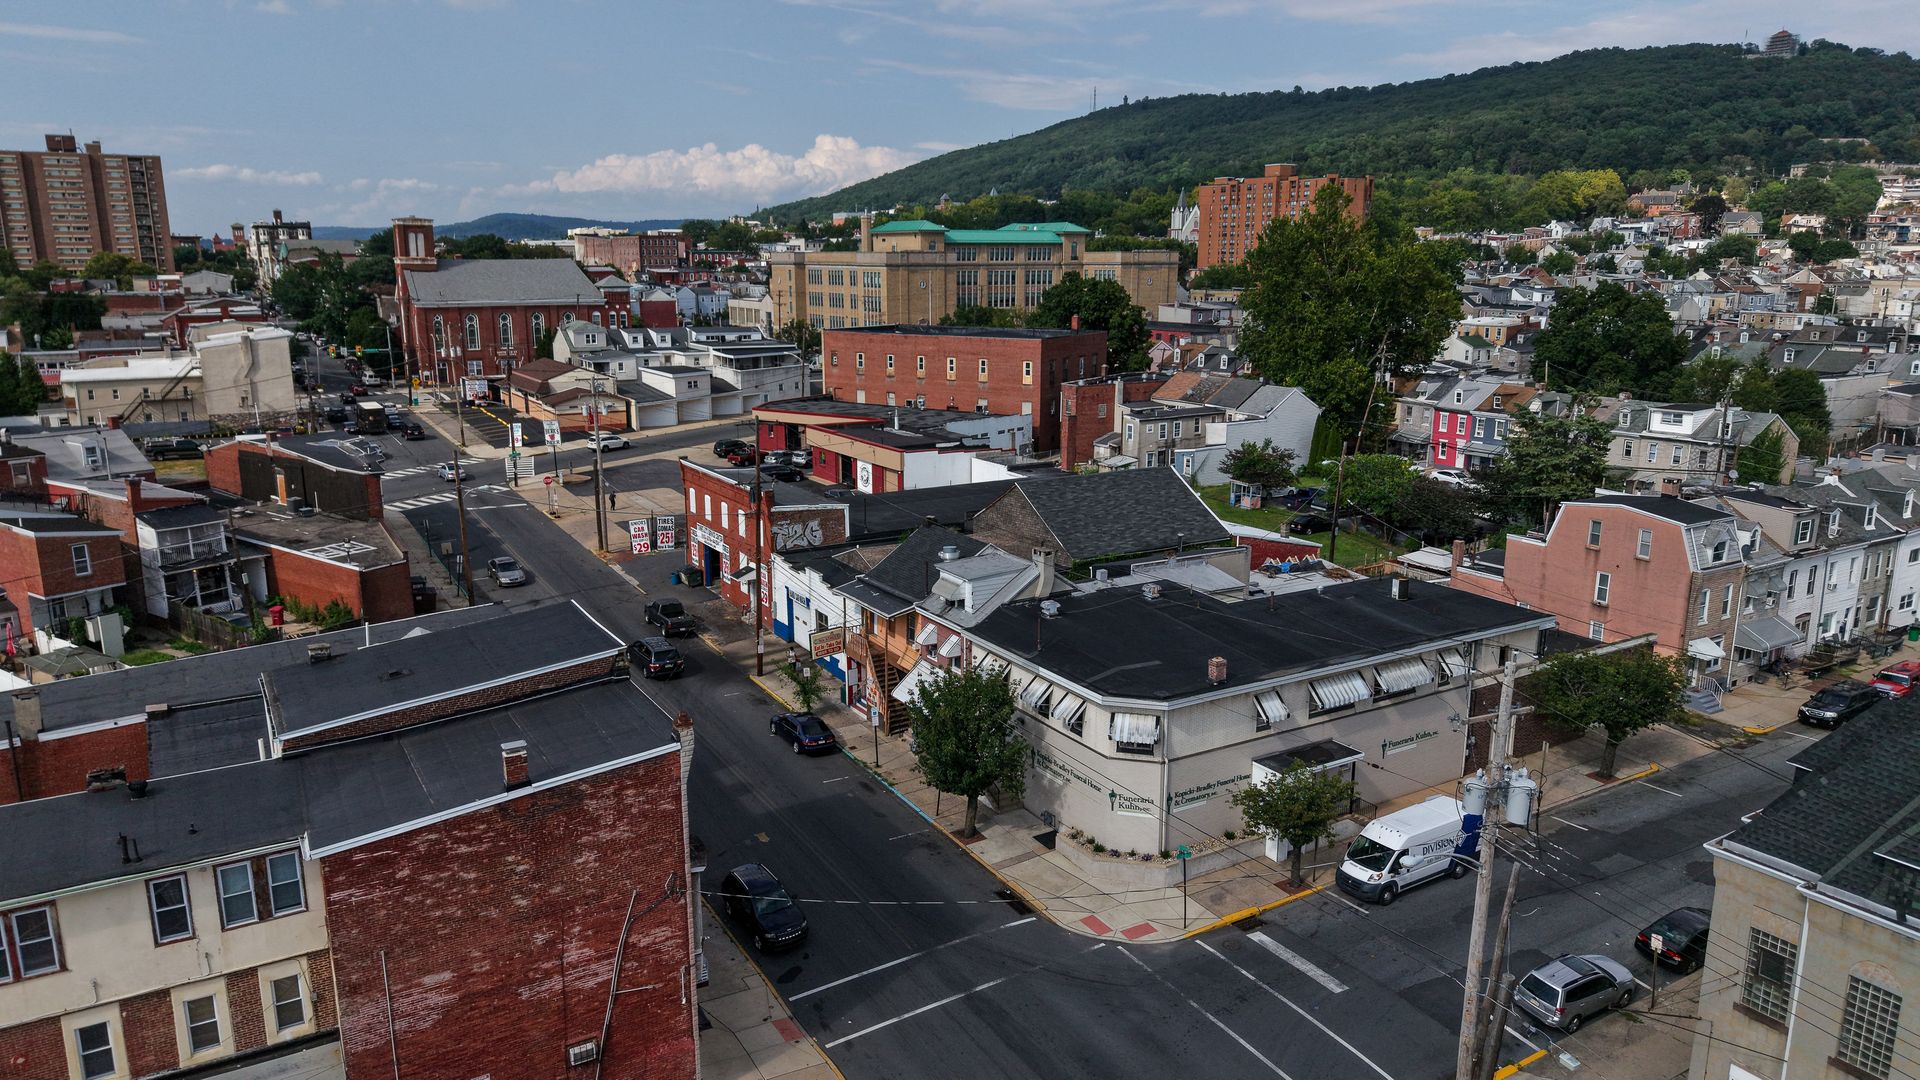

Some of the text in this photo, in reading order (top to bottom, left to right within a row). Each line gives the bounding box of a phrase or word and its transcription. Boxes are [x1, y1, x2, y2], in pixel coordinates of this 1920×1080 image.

[634, 542, 650, 553] $29
[1388, 736, 1415, 748] Funeraria
[1070, 769, 1088, 785] Funeral
[1087, 778, 1102, 793] Home
[1216, 775, 1236, 788] Funeral
[1236, 773, 1252, 782] Home
[1118, 793, 1154, 804] Funeraria
[1422, 838, 1455, 857] DIVISION
